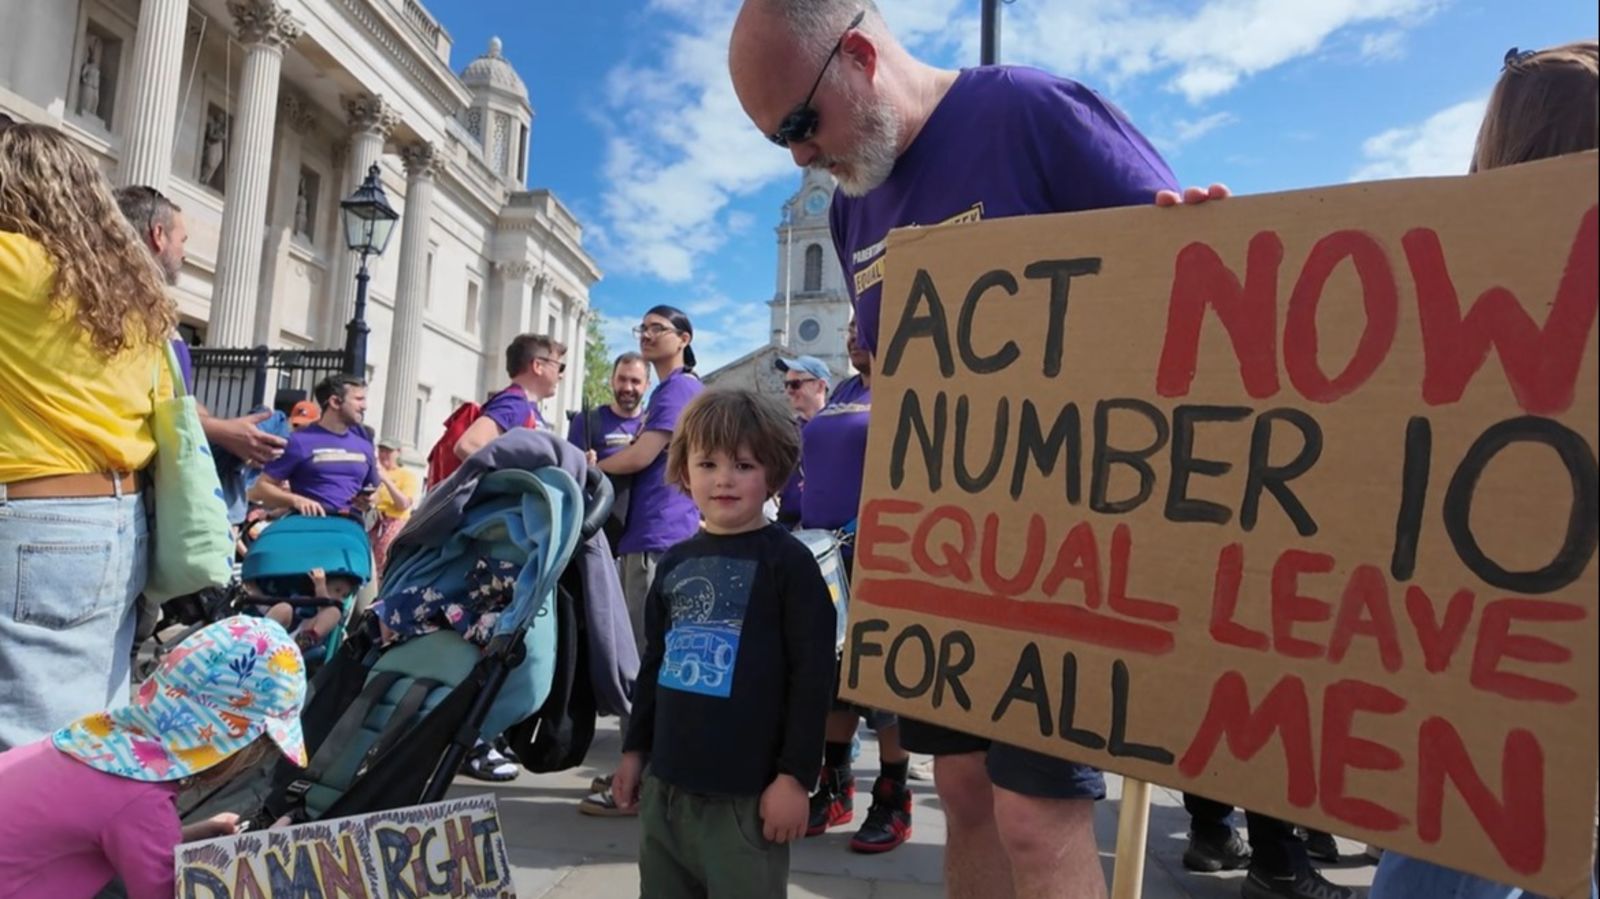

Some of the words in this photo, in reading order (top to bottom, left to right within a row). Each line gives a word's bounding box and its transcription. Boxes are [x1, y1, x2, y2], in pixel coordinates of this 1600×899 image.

[856, 261, 882, 291] EQUAL
[881, 257, 1102, 378] ACT
[1156, 204, 1598, 415] NOW
[889, 388, 1323, 536] NUMBER
[1391, 415, 1599, 594] 10
[857, 499, 1180, 622] EQUAL
[1209, 543, 1587, 704] LEAVE
[848, 619, 975, 712] FOR
[991, 642, 1175, 765] ALL
[1178, 670, 1546, 877] MEN
[182, 834, 368, 899] DAMN
